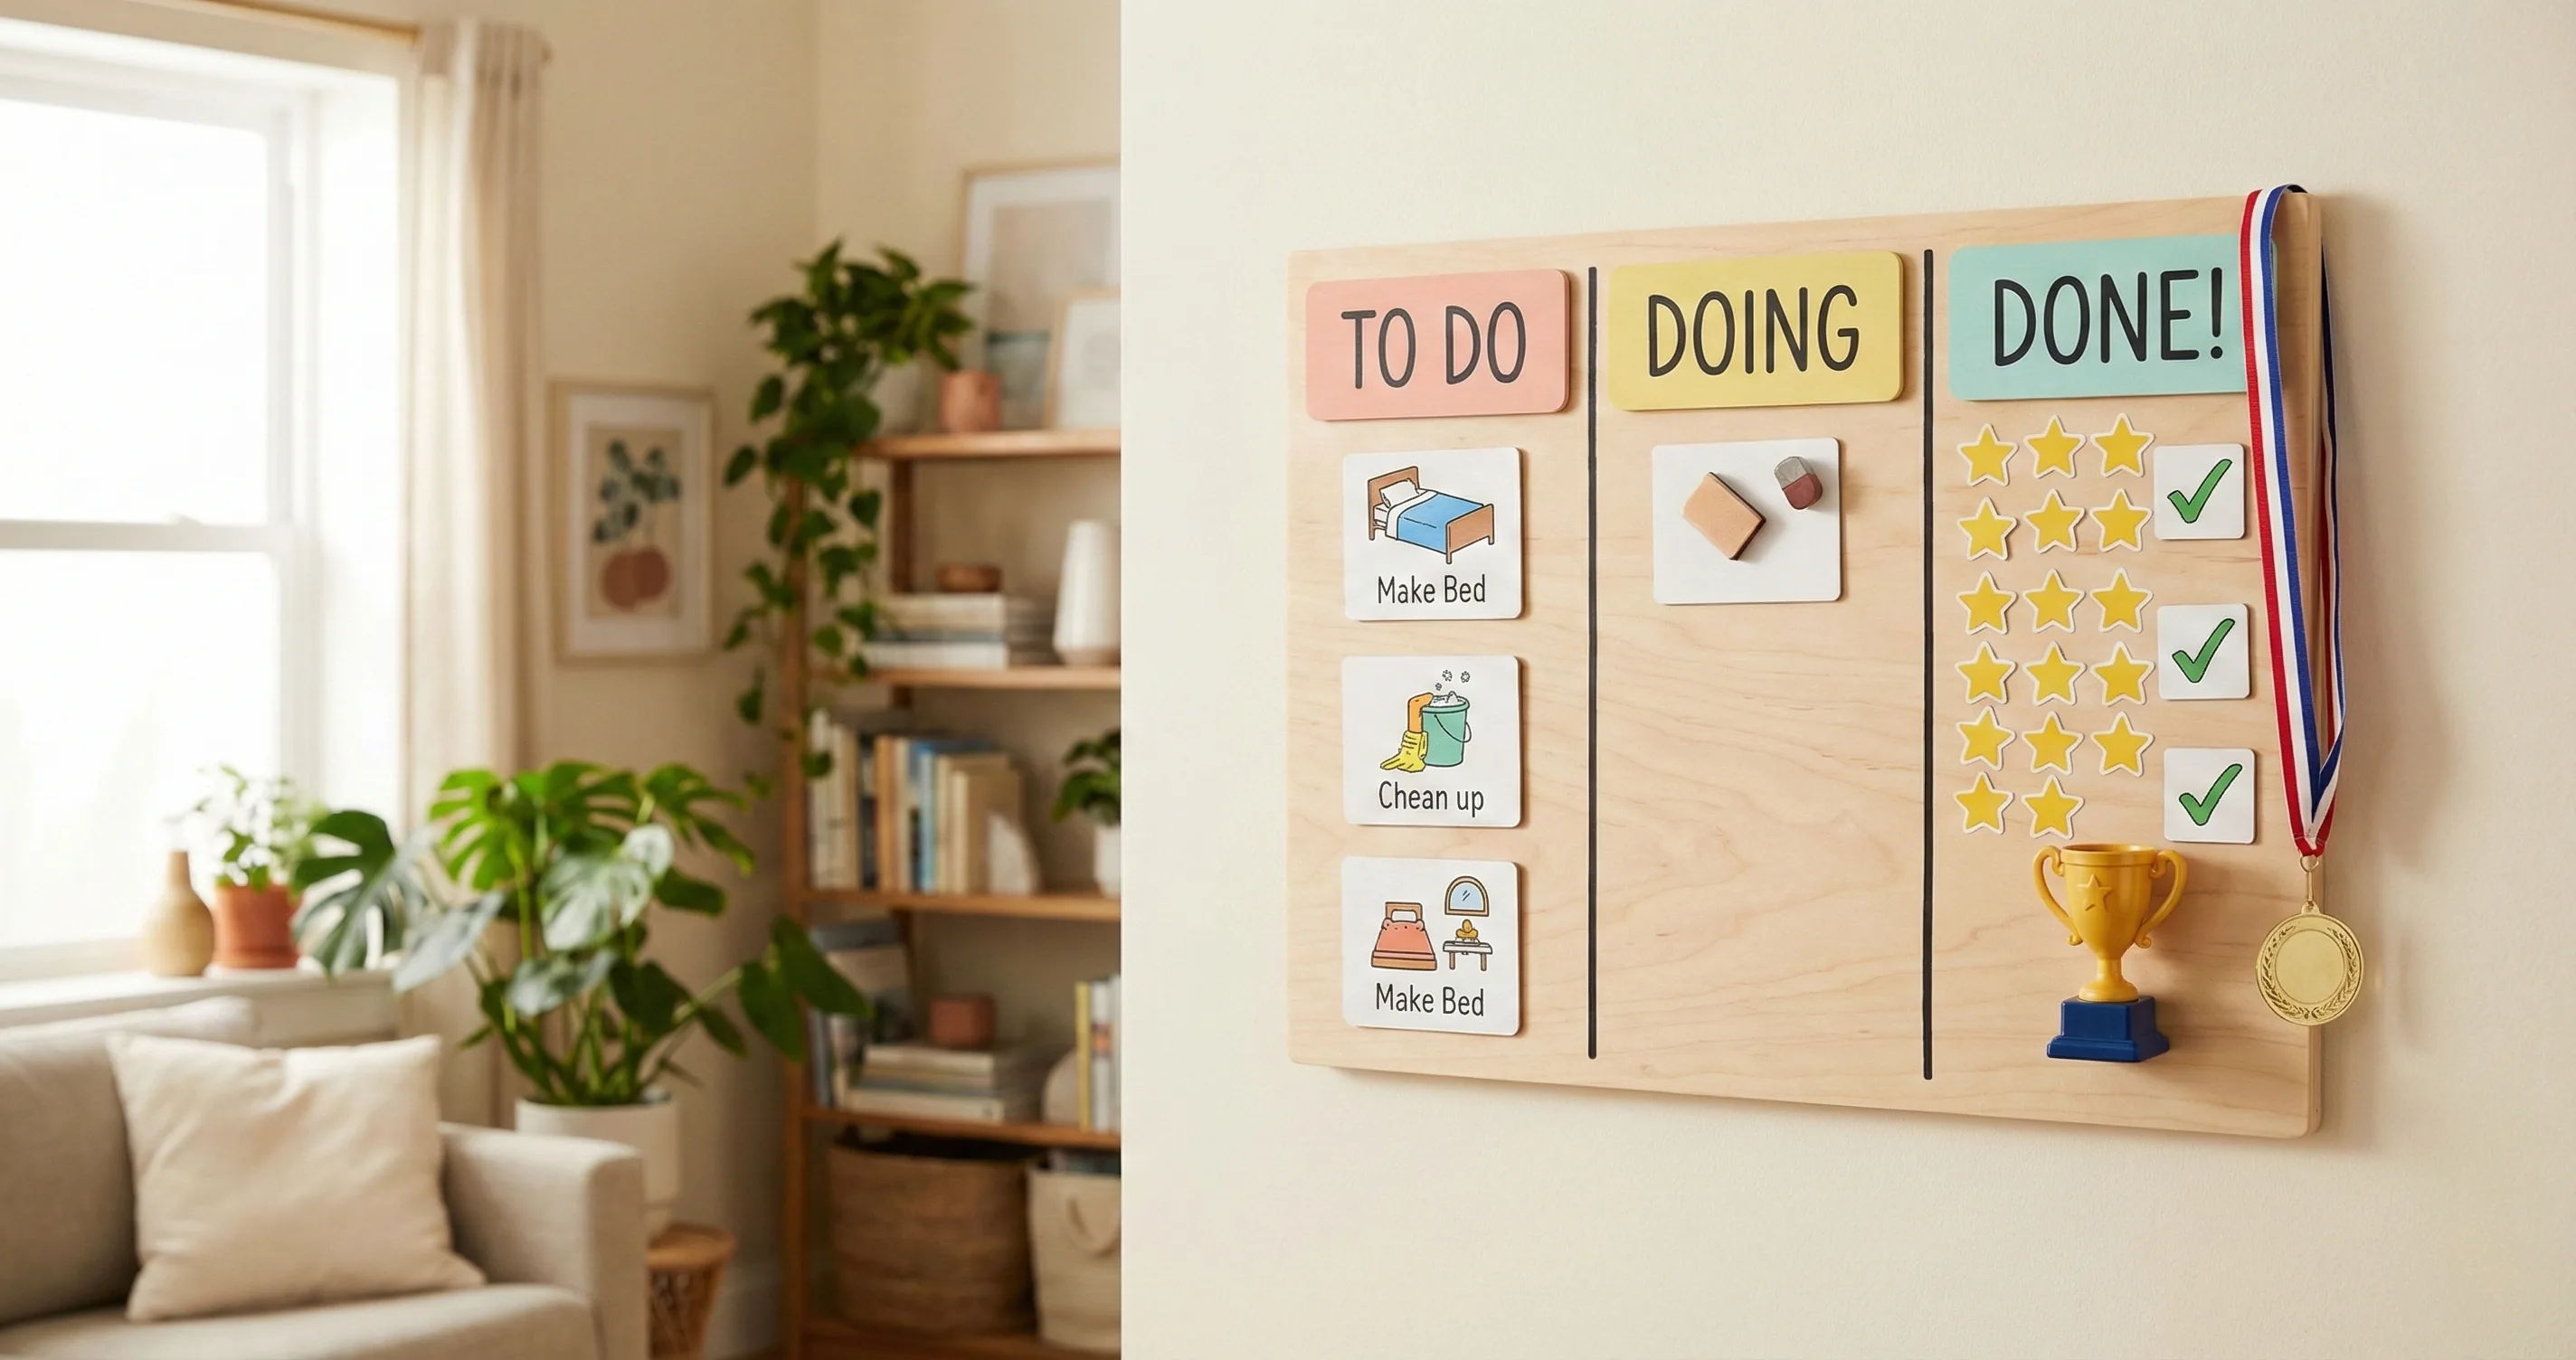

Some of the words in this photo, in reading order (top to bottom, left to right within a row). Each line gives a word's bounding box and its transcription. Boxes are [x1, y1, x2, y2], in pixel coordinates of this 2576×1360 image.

[1340, 307, 1416, 390] TO
[1445, 301, 1527, 385] DO
[1648, 284, 1860, 378] DOING
[1994, 267, 2224, 367] DONE!
[1378, 575, 1435, 604] Make
[1444, 573, 1486, 603] Bed
[1378, 780, 1448, 810] Chean
[1456, 790, 1484, 817] up
[1376, 982, 1435, 1014] Make
[1443, 986, 1484, 1017] Bed
